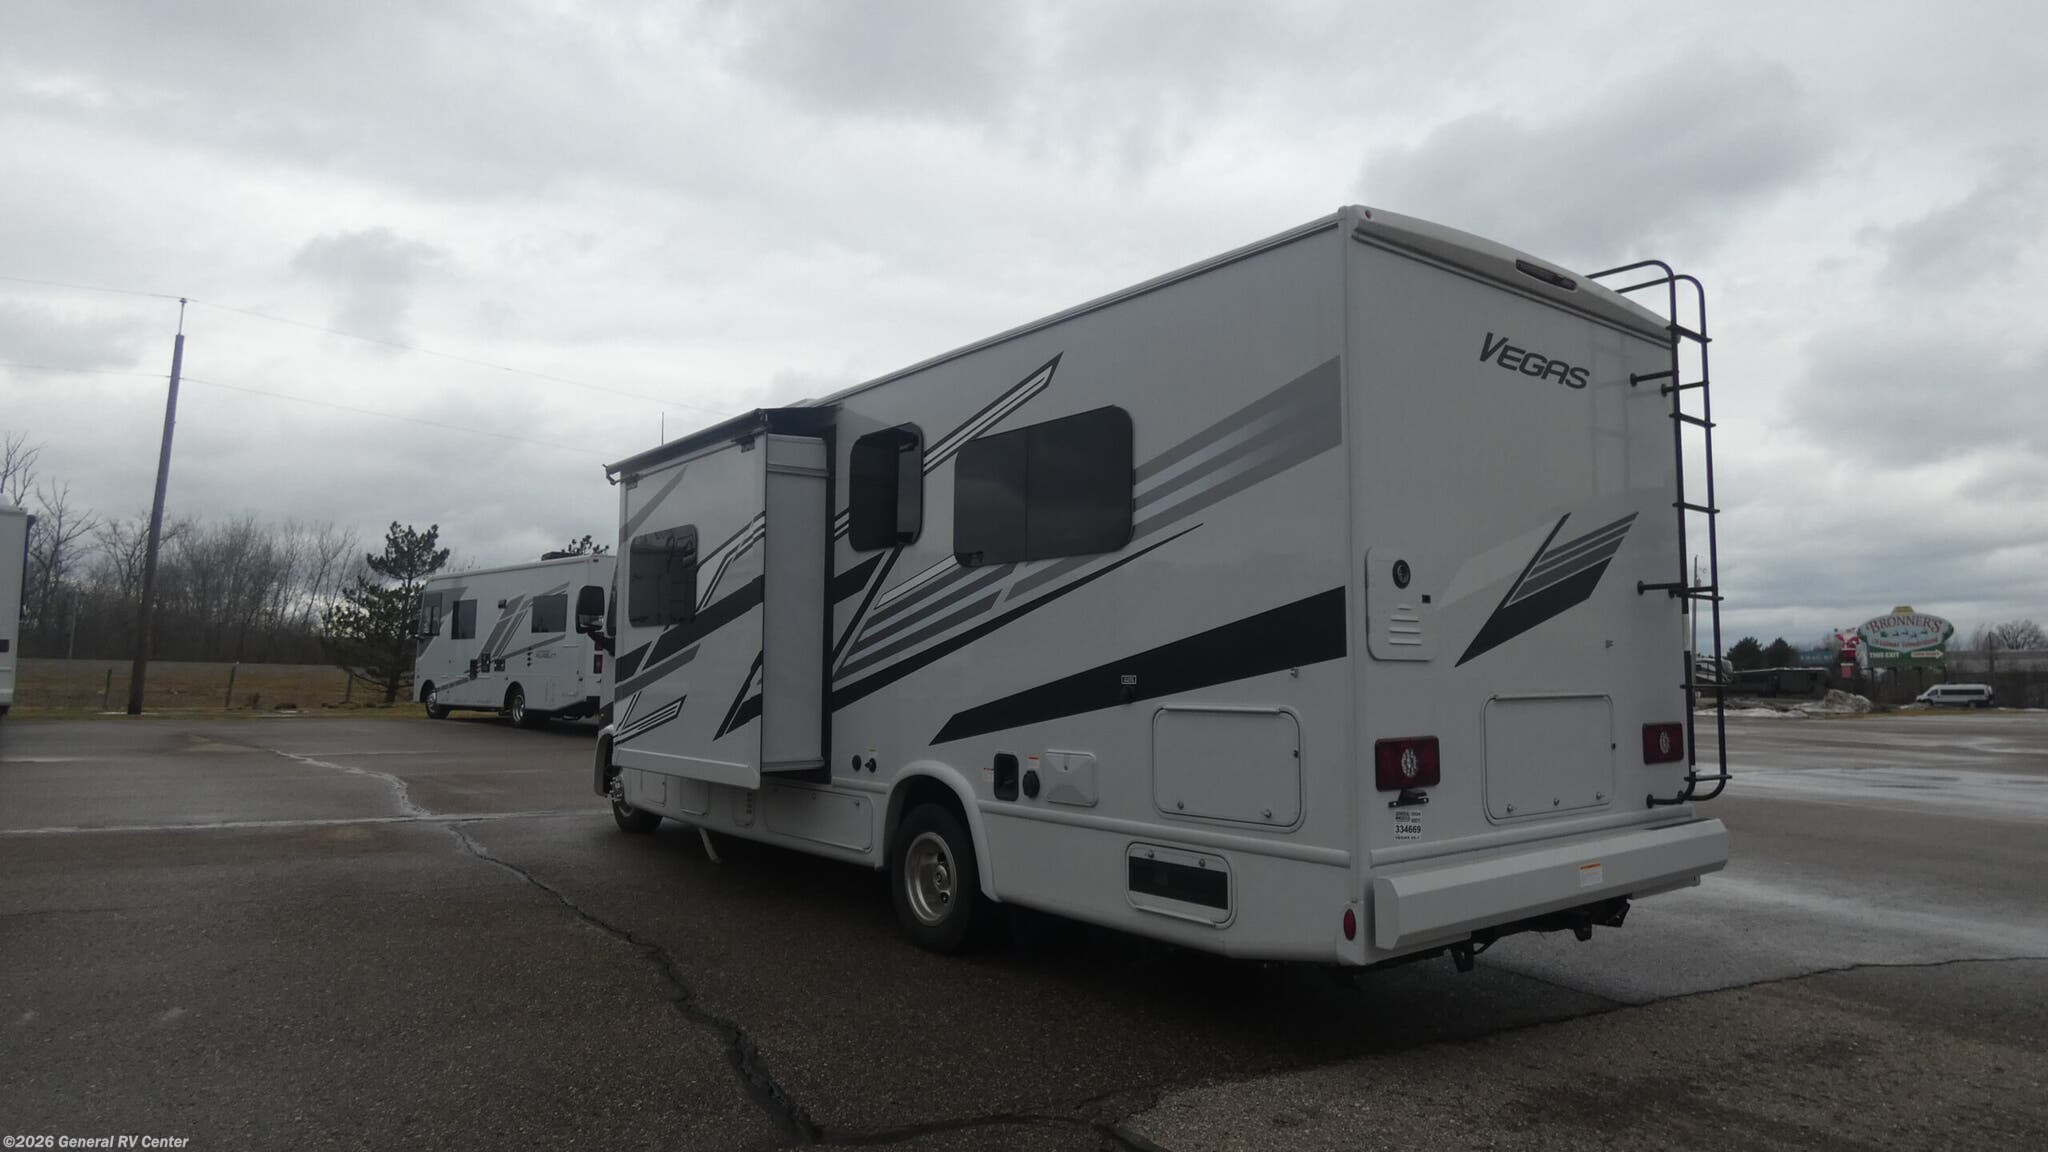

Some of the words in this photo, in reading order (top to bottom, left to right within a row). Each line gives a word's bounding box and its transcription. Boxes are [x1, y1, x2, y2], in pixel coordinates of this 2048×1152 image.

[1480, 332, 1590, 389] VEGAS
[1866, 615, 1943, 634] BRONNER'S
[1395, 825, 1421, 834] 334669
